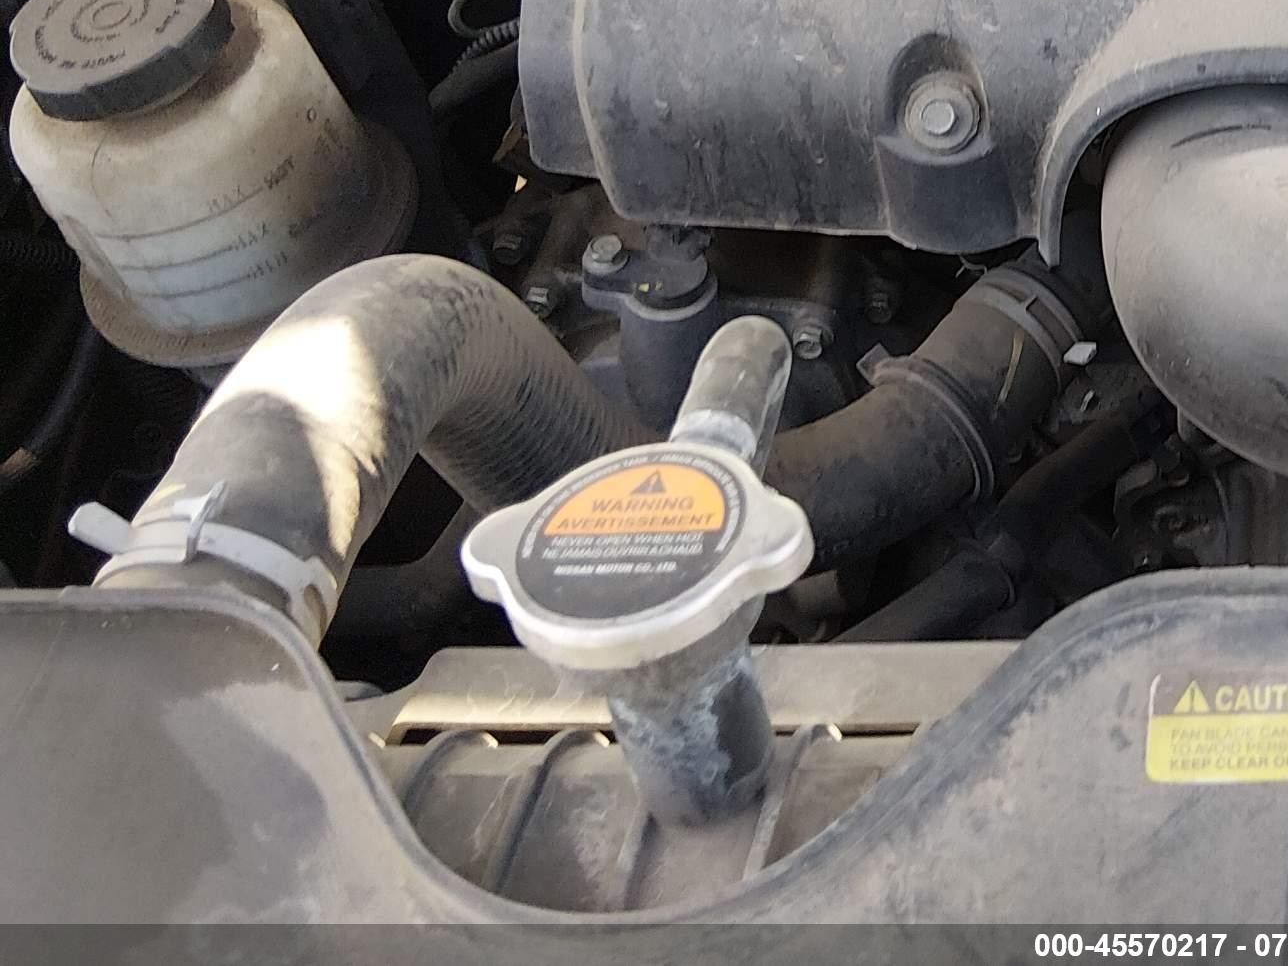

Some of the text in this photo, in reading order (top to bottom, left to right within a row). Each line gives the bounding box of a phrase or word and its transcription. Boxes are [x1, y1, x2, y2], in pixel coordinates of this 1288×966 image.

[592, 496, 696, 513] WARNING
[556, 512, 718, 531] AVERTISSEMENT
[551, 535, 594, 547] NEVER
[595, 534, 632, 546] OPEN
[633, 533, 674, 545] WHEN
[560, 545, 601, 558] JAMAIS
[553, 564, 594, 576] NISSAN
[595, 563, 635, 575] MOTOR
[1170, 757, 1211, 771] KEEP
[1215, 756, 1269, 769] CLEAR
